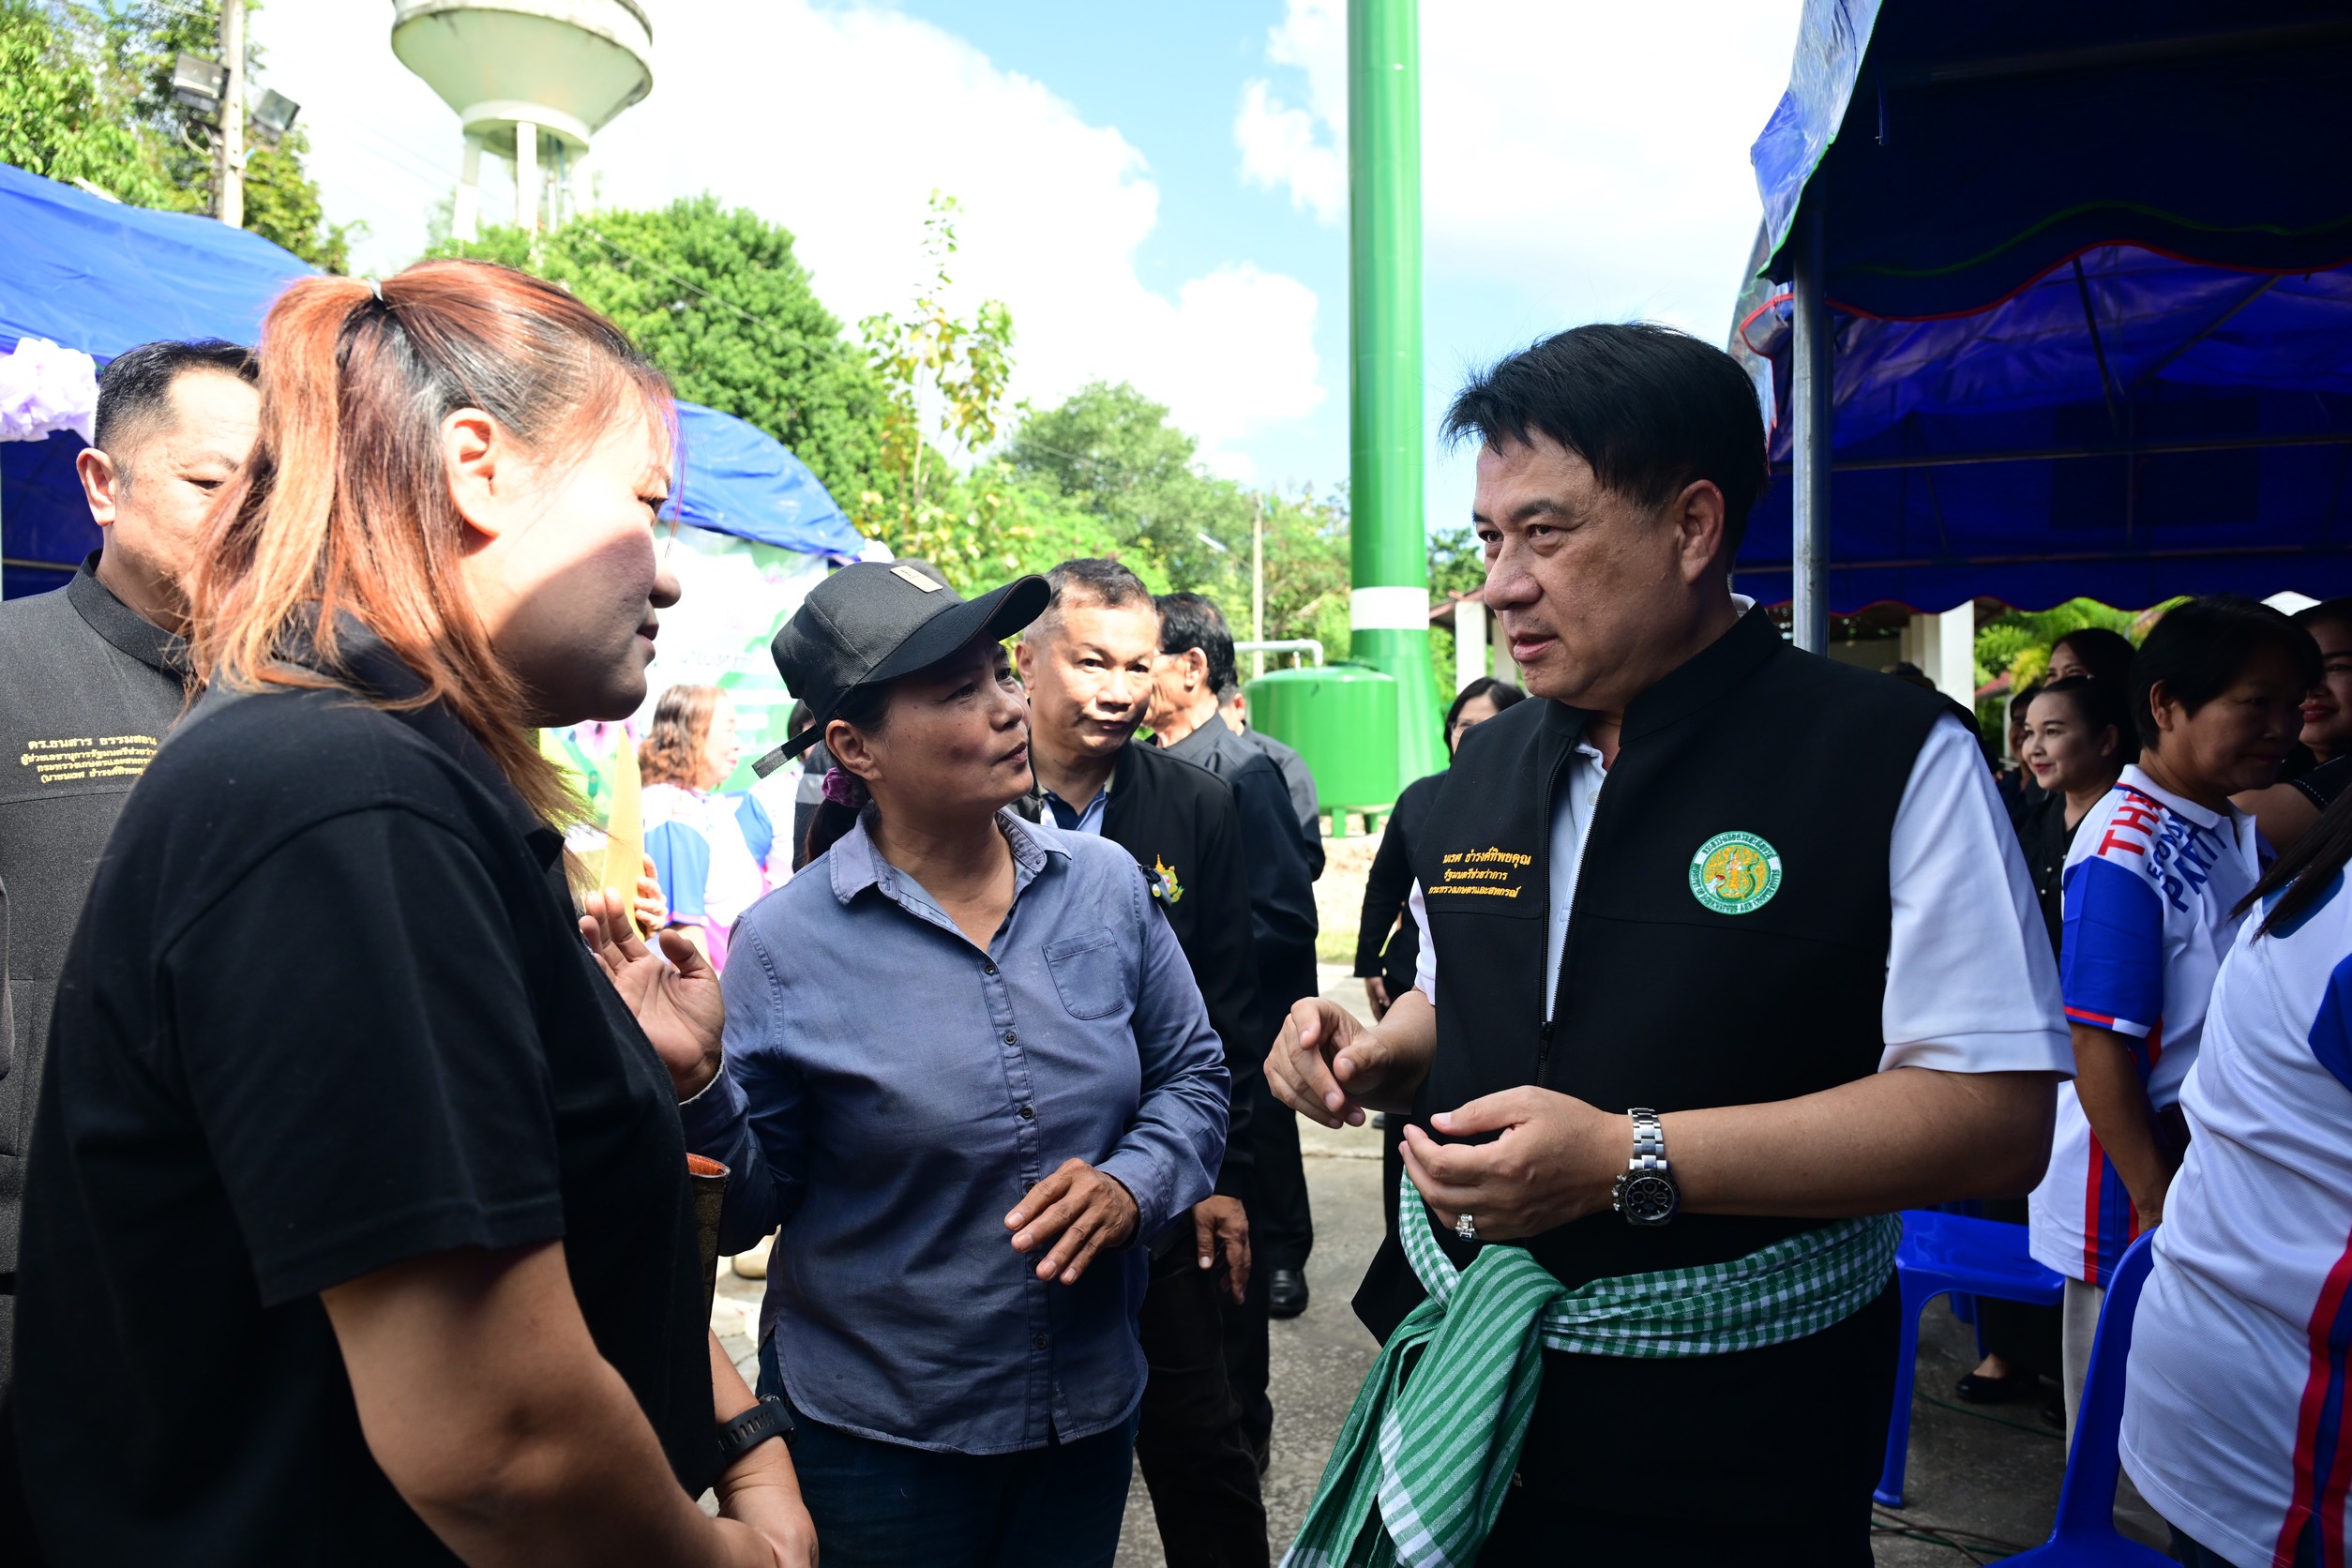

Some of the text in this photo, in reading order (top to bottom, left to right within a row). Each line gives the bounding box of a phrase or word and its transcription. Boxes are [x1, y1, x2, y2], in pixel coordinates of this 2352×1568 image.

[1442, 852, 1463, 864] นเรศ
[1443, 867, 1508, 882] รัฐมนตรีช่วยว่าการ
